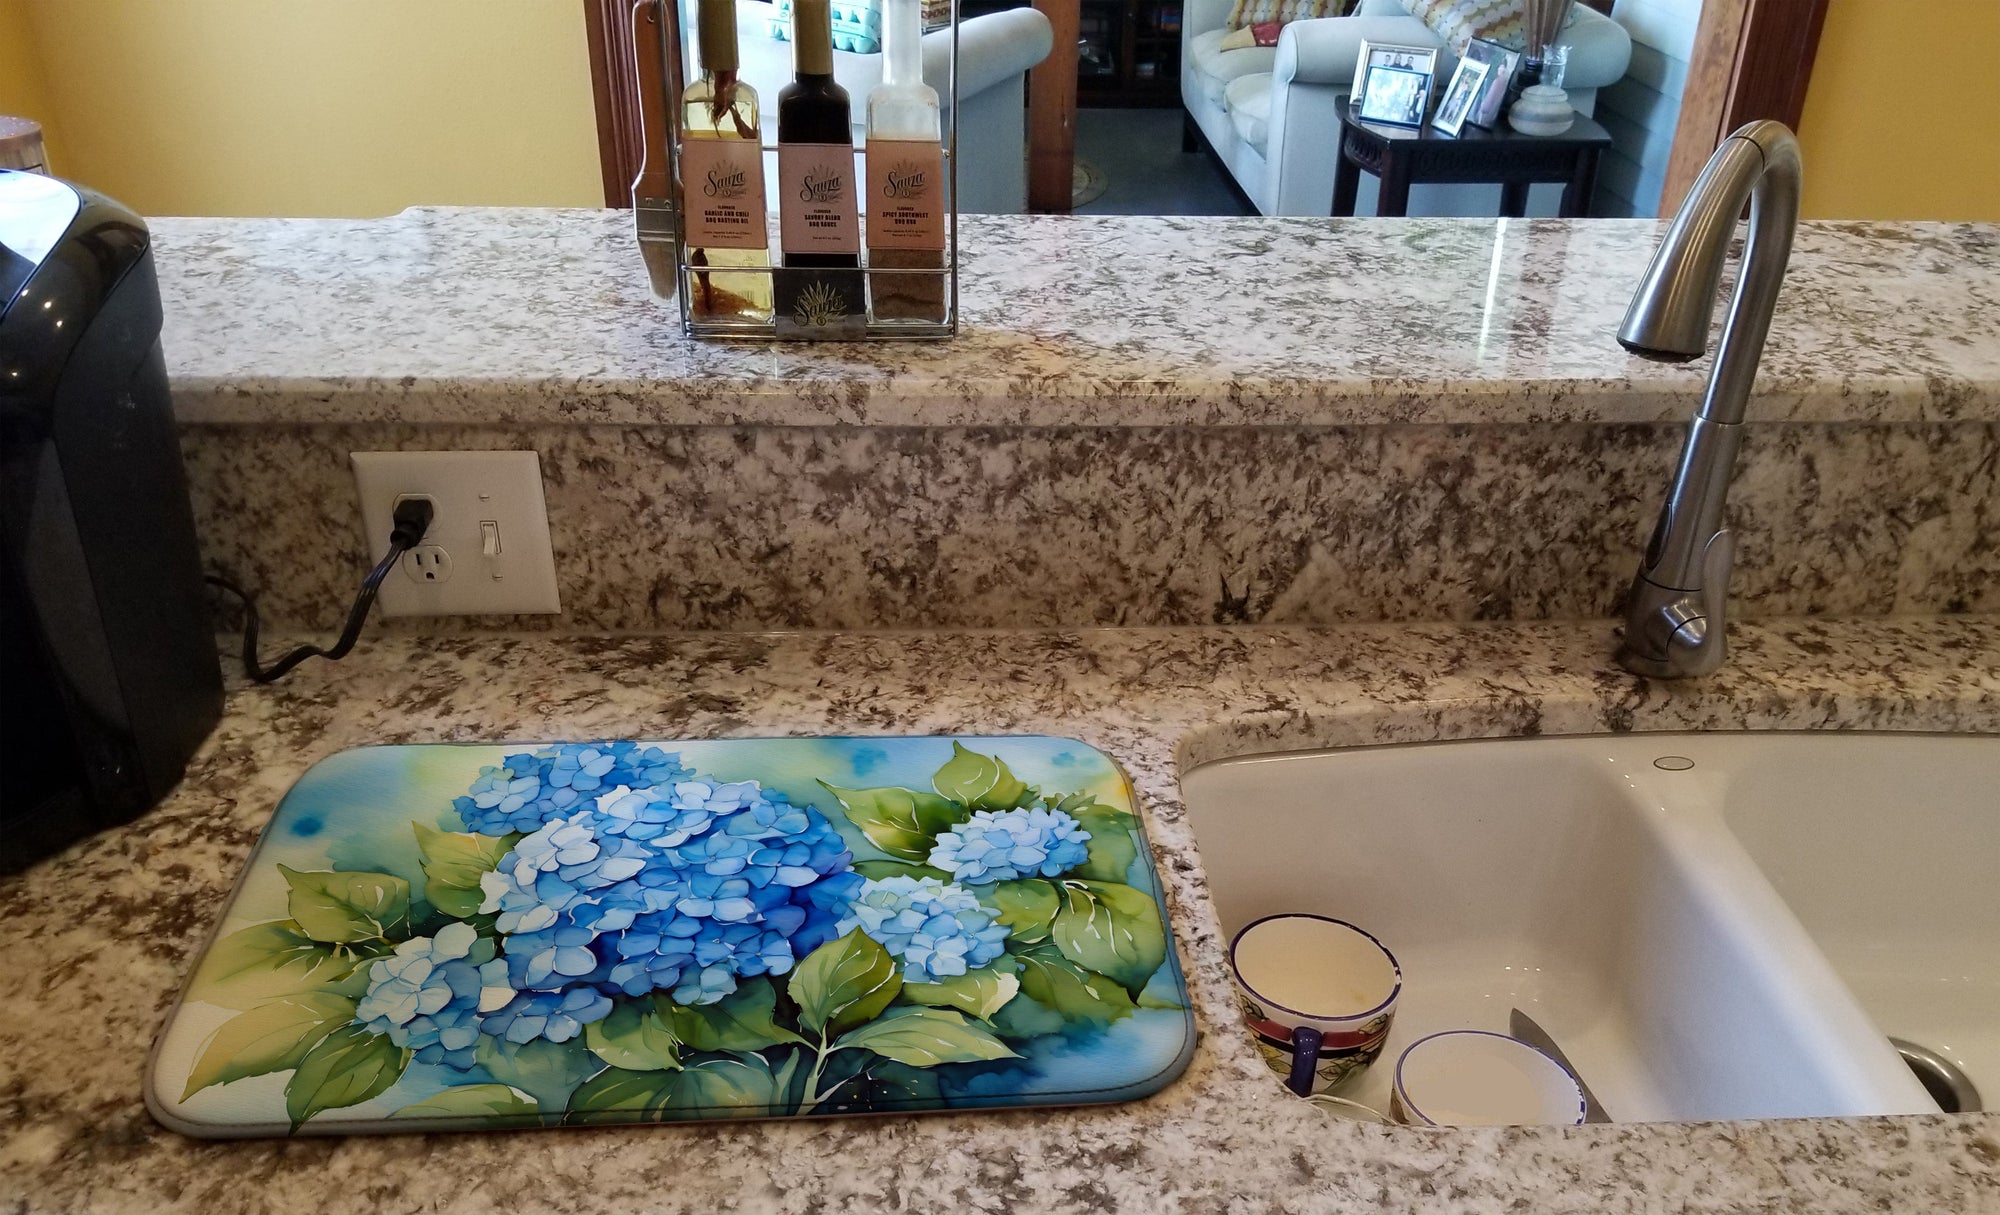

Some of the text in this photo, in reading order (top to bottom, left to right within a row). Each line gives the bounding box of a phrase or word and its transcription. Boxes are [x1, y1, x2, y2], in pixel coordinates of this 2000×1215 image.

[703, 169, 745, 197] Sauza
[800, 175, 842, 202] Sauza
[883, 170, 926, 198] Sauza
[793, 295, 844, 327] Sauza
